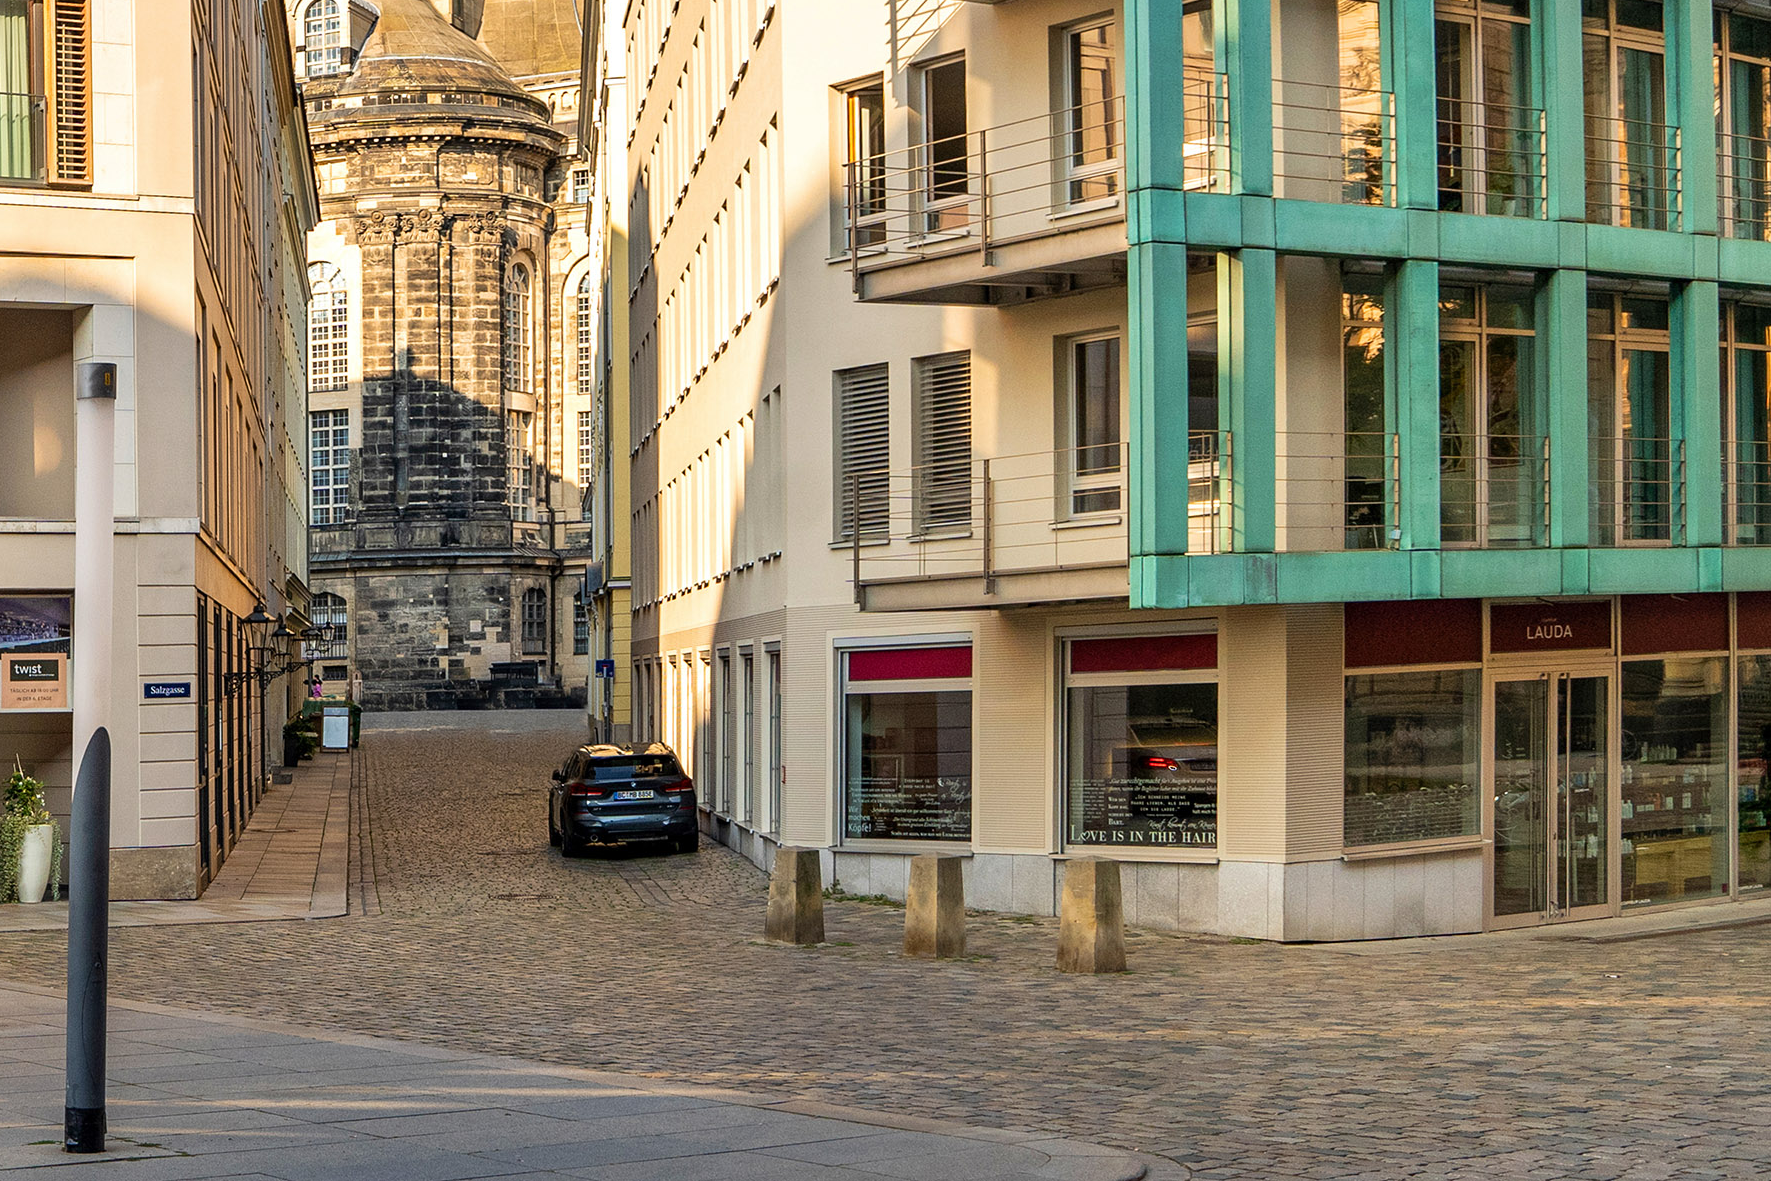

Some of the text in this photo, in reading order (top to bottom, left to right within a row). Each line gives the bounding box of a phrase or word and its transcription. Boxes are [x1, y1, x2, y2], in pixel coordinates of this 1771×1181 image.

[1526, 624, 1573, 640] LAUDA
[14, 663, 42, 675] twist
[150, 685, 185, 696] Salzgasse
[1112, 830, 1125, 842] IS
[1129, 830, 1144, 842] IN
[1149, 830, 1177, 843] THE
[1182, 831, 1217, 844] HAIR
